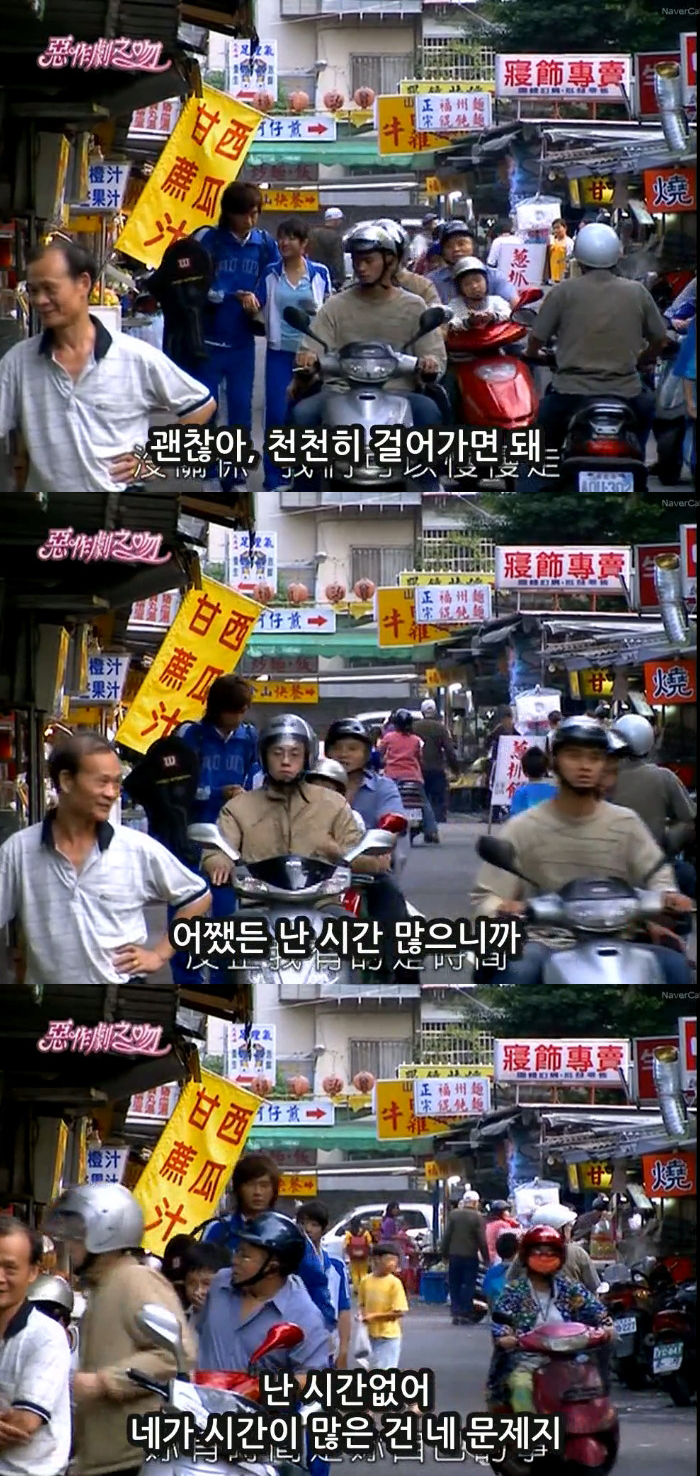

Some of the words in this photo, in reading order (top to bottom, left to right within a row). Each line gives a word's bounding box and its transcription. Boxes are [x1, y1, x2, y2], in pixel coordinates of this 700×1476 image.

[192, 118, 252, 219] 西瓜
[653, 176, 692, 205] 燒
[652, 668, 692, 697] 燒
[188, 1103, 252, 1203] 西瓜
[652, 1160, 691, 1190] 燒
